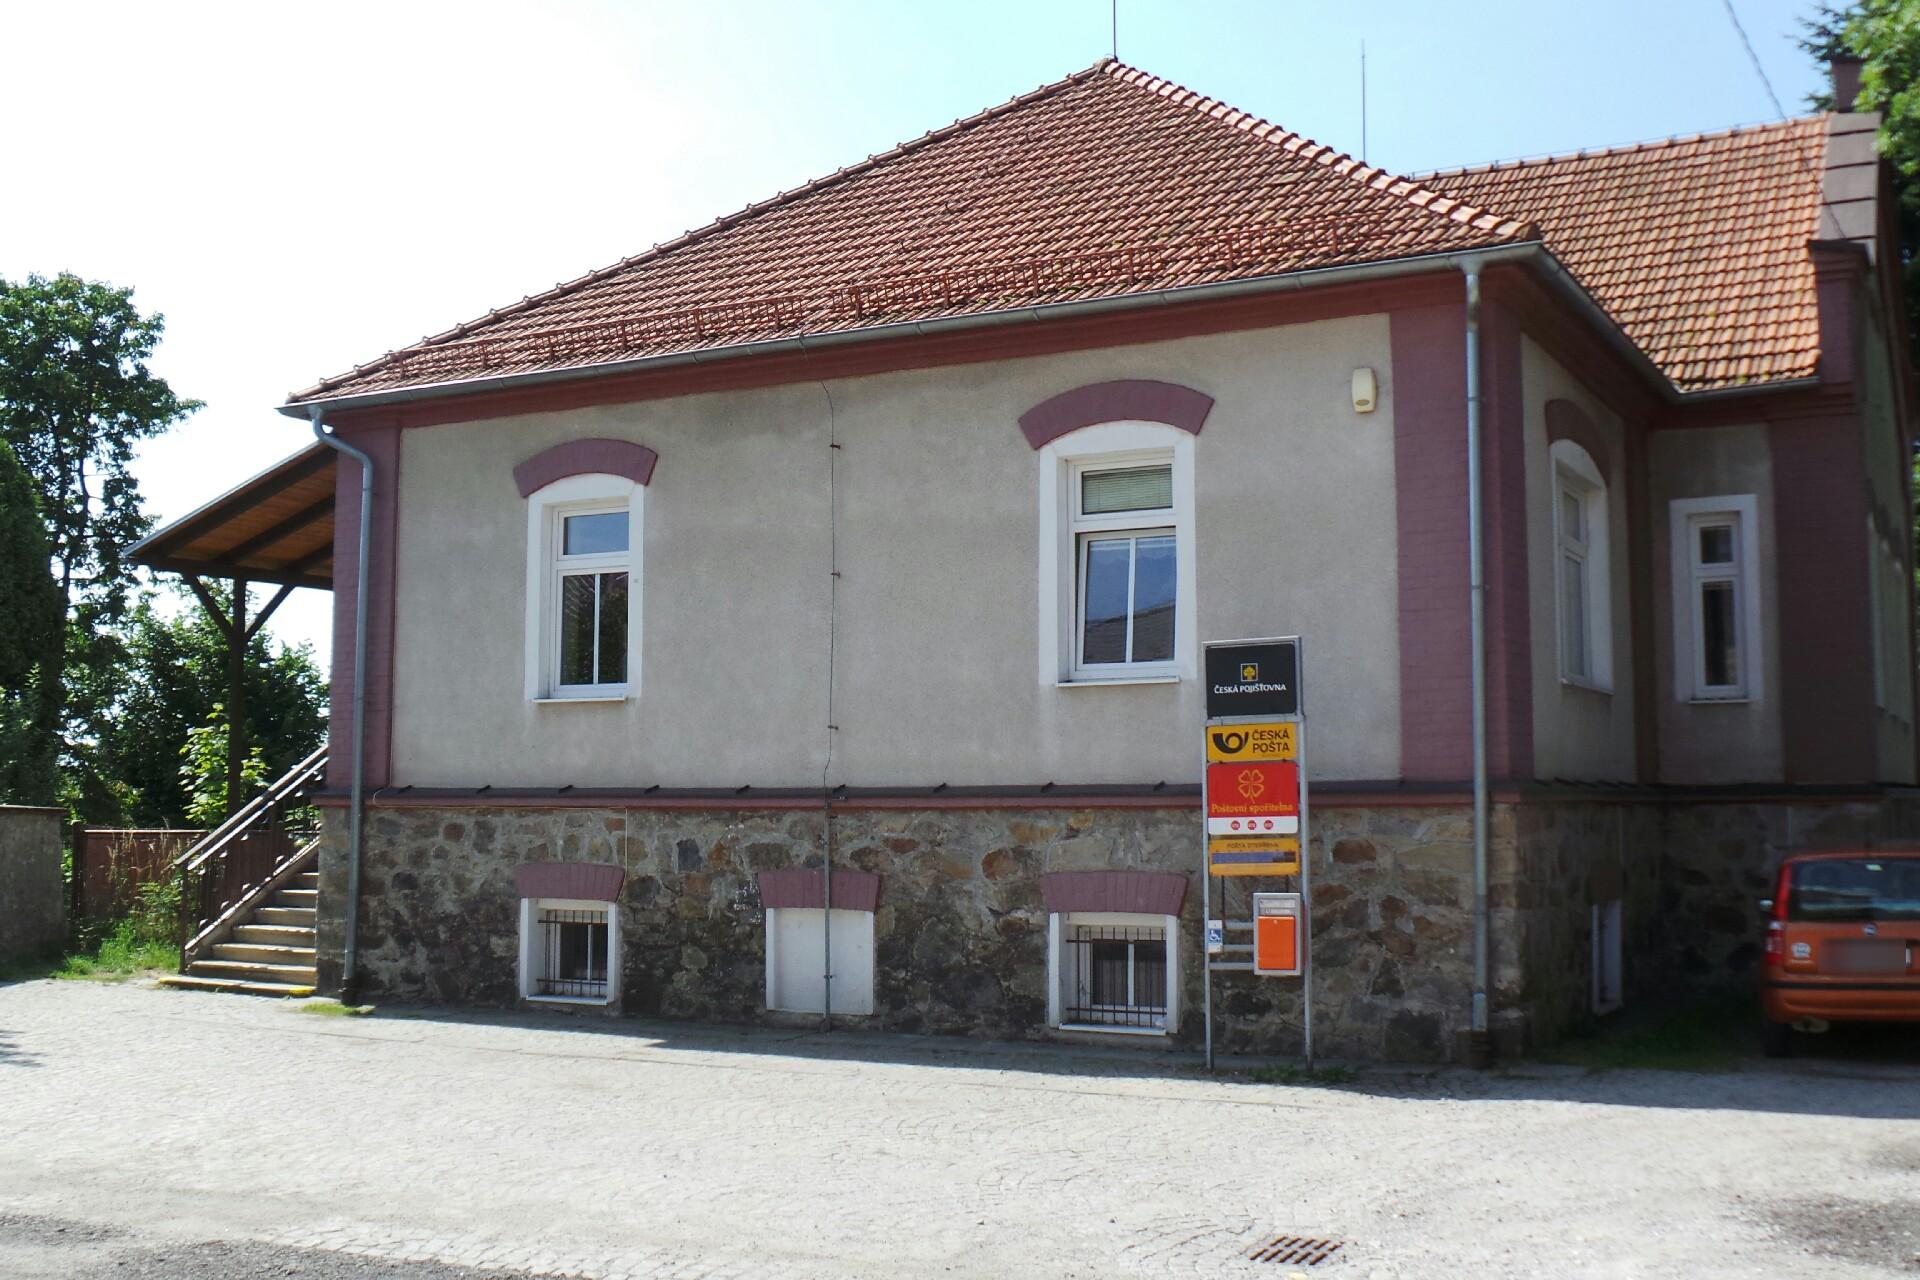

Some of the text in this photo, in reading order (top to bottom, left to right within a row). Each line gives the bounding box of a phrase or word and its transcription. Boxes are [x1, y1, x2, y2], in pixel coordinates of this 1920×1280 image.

[1214, 684, 1239, 694] ČESKÁ
[1252, 728, 1290, 741] ČESKÁ
[1252, 741, 1290, 753] POŠTA
[1211, 802, 1293, 813] Poštovní spořitelna
